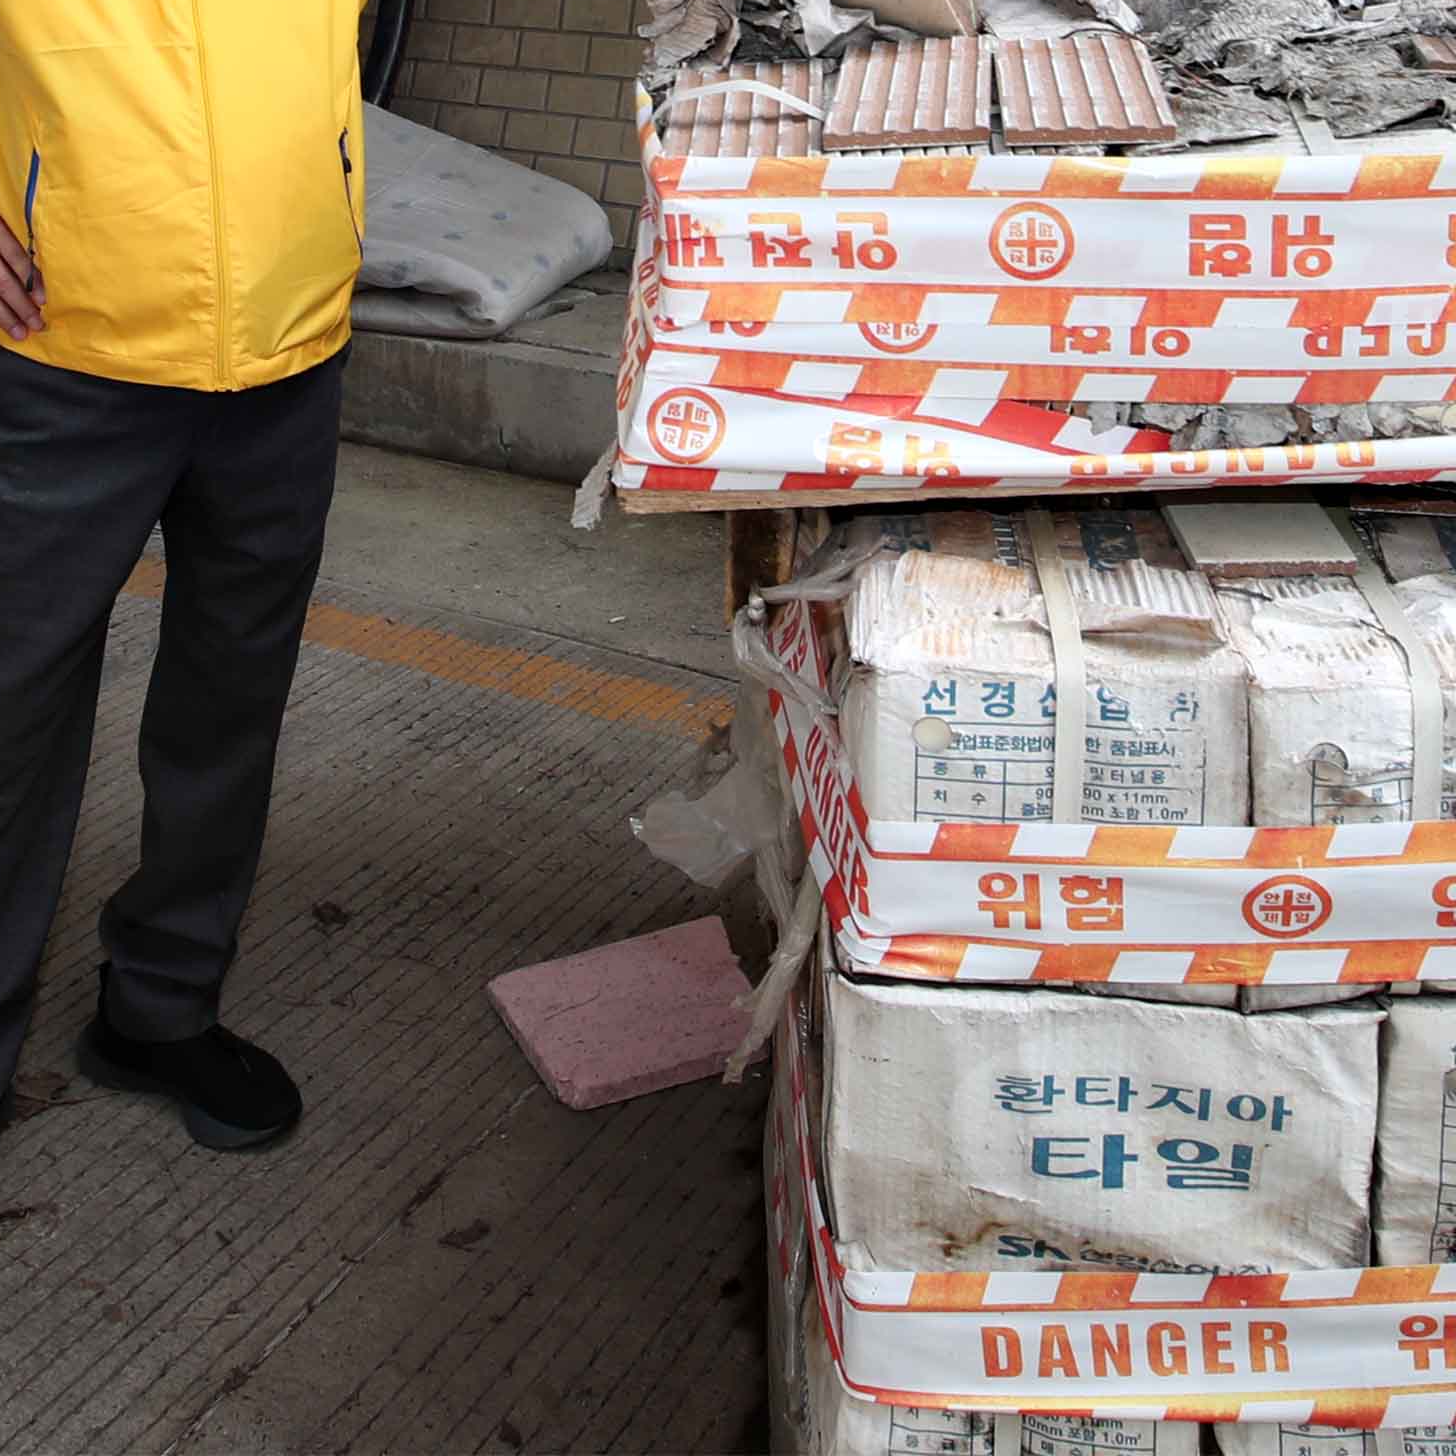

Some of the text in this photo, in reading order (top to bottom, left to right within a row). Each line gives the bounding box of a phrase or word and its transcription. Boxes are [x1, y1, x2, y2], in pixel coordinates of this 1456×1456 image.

[661, 210, 899, 271] 안전제
[1188, 212, 1335, 278] 위험
[977, 872, 1125, 932] 위험
[993, 1074, 1293, 1132] 환타지아
[1031, 1133, 1254, 1191] 타일
[980, 1321, 1291, 1379] DANGER
